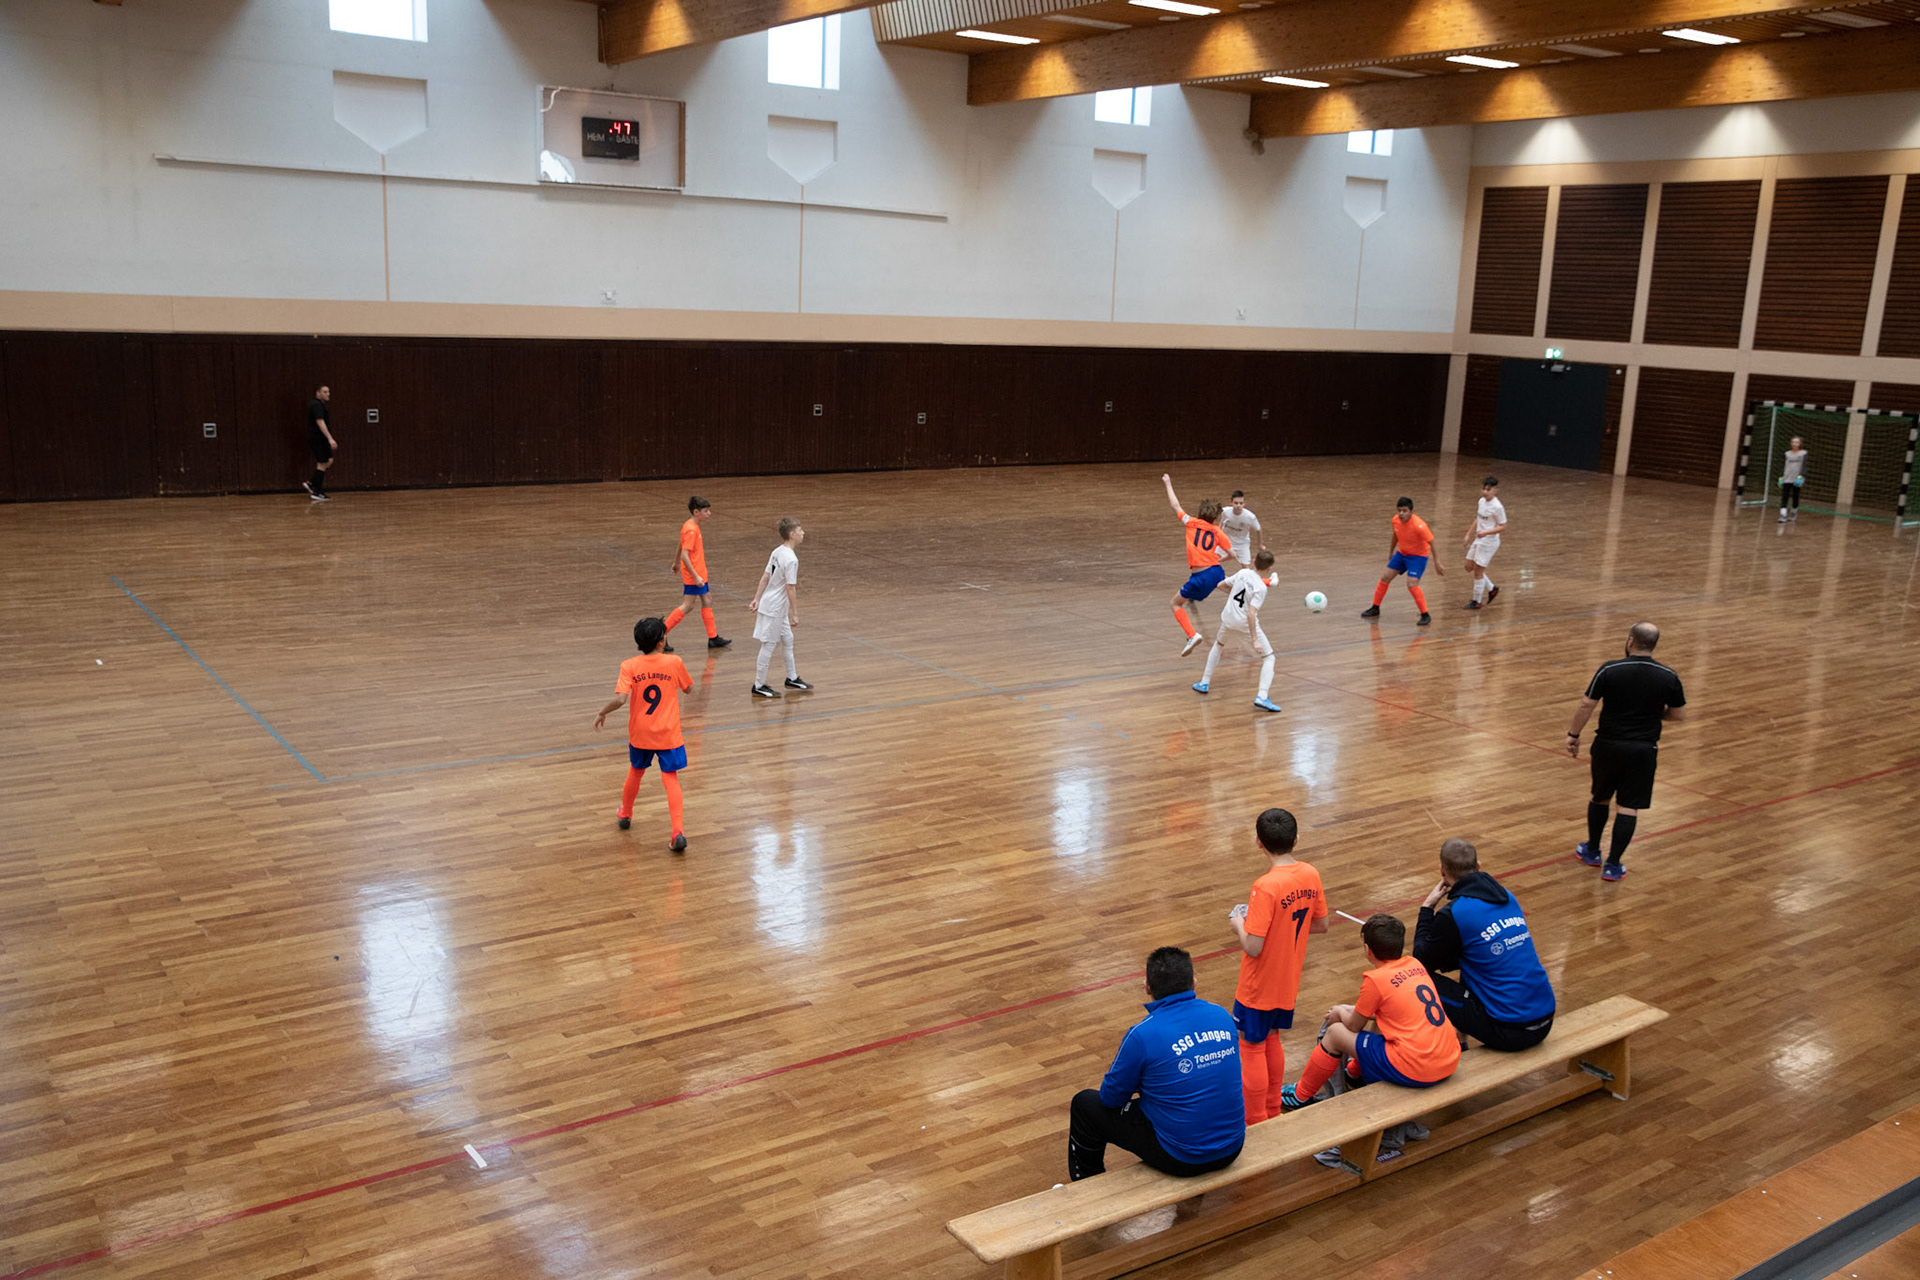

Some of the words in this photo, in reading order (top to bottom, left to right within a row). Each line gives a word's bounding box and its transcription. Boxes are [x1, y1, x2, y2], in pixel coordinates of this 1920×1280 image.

[1193, 528, 1215, 551] 10
[1233, 588, 1247, 609] 4
[632, 673, 646, 684] SSG
[647, 672, 672, 682] Langen
[643, 684, 662, 715] 9
[1280, 891, 1296, 909] SSG
[1292, 907, 1310, 951] 7
[1480, 922, 1502, 941] SSG
[1390, 971, 1407, 988] SSG
[1416, 985, 1446, 1027] 8
[1171, 1034, 1195, 1056] SSG
[1193, 1030, 1232, 1043] Langen
[1193, 1045, 1236, 1064] Teamsport
